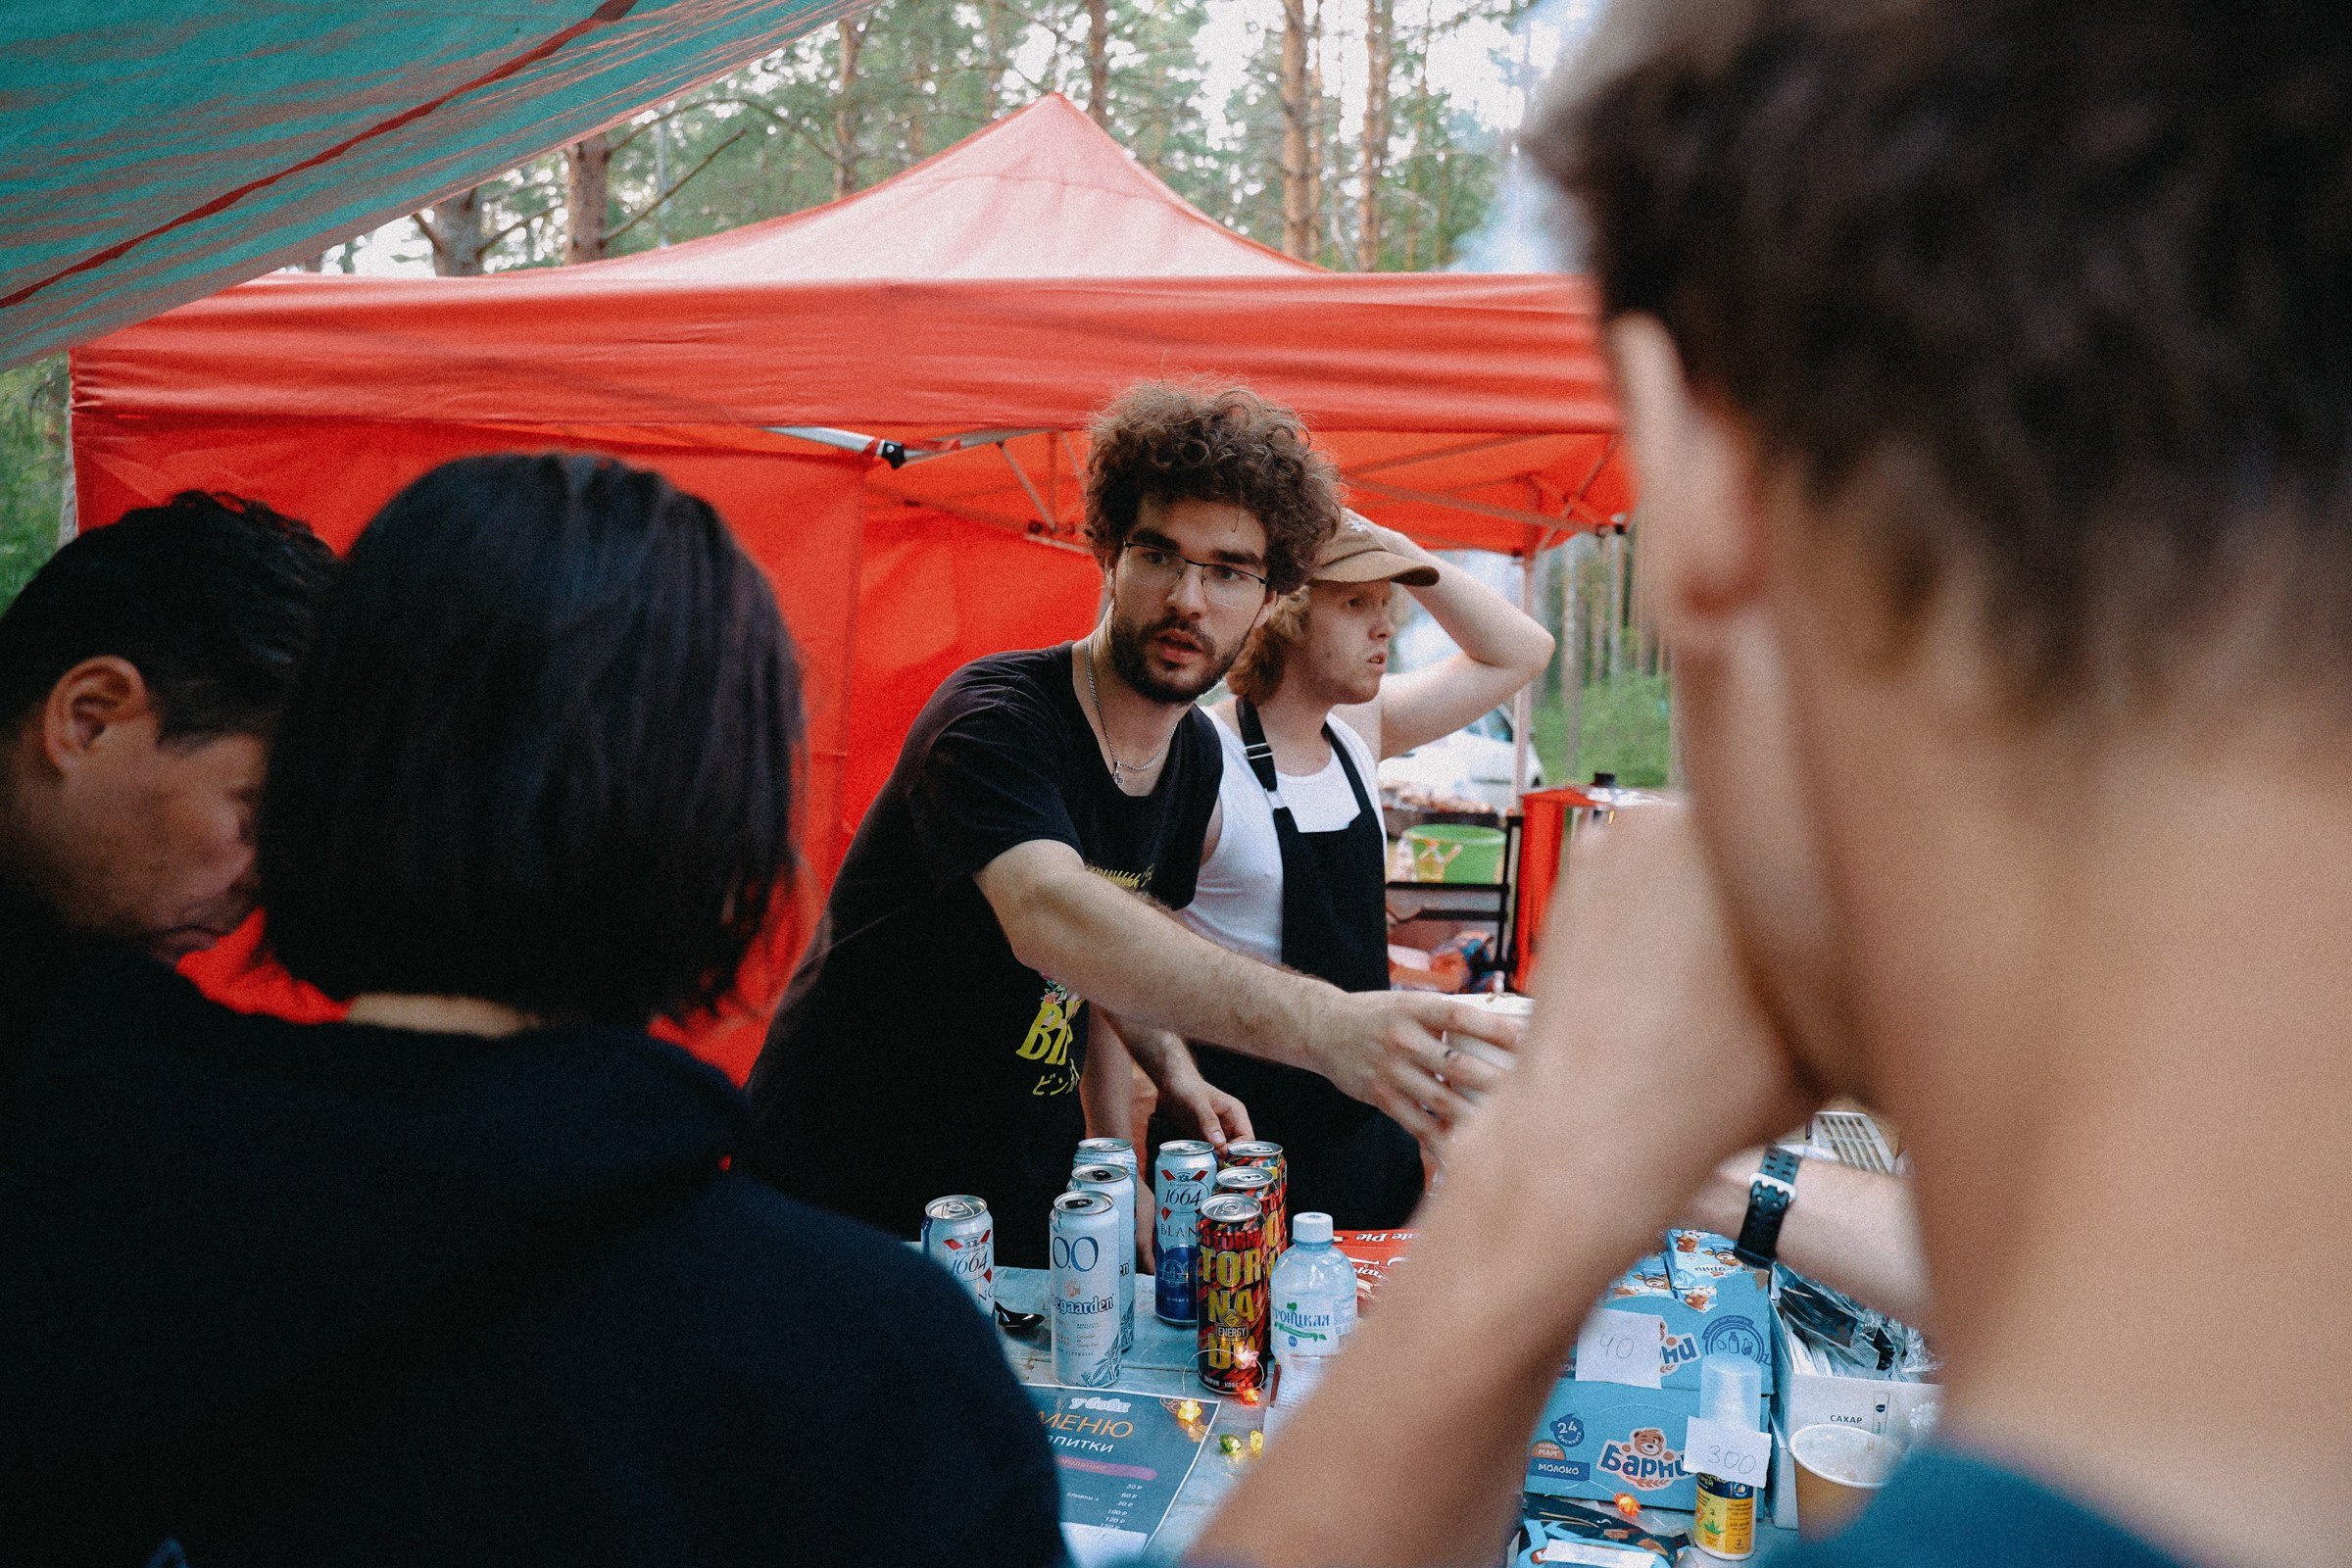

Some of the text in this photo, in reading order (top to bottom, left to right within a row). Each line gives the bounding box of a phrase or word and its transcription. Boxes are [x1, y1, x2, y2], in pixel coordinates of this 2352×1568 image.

[1164, 1188, 1203, 1206] 1664
[1160, 1223, 1197, 1238] BLAN
[1356, 1233, 1389, 1242] Pie
[952, 1250, 990, 1275] 1664
[1200, 1245, 1262, 1287] TOR
[1052, 1294, 1114, 1314] egaarden
[1207, 1288, 1254, 1323] NA
[1217, 1326, 1247, 1338] ENERGY
[1599, 1334, 1635, 1360] 40
[1037, 1411, 1134, 1438] МЕНЮ
[1557, 1420, 1578, 1434] 24
[1830, 1414, 1863, 1424] САХАР
[1707, 1445, 1756, 1474] 300
